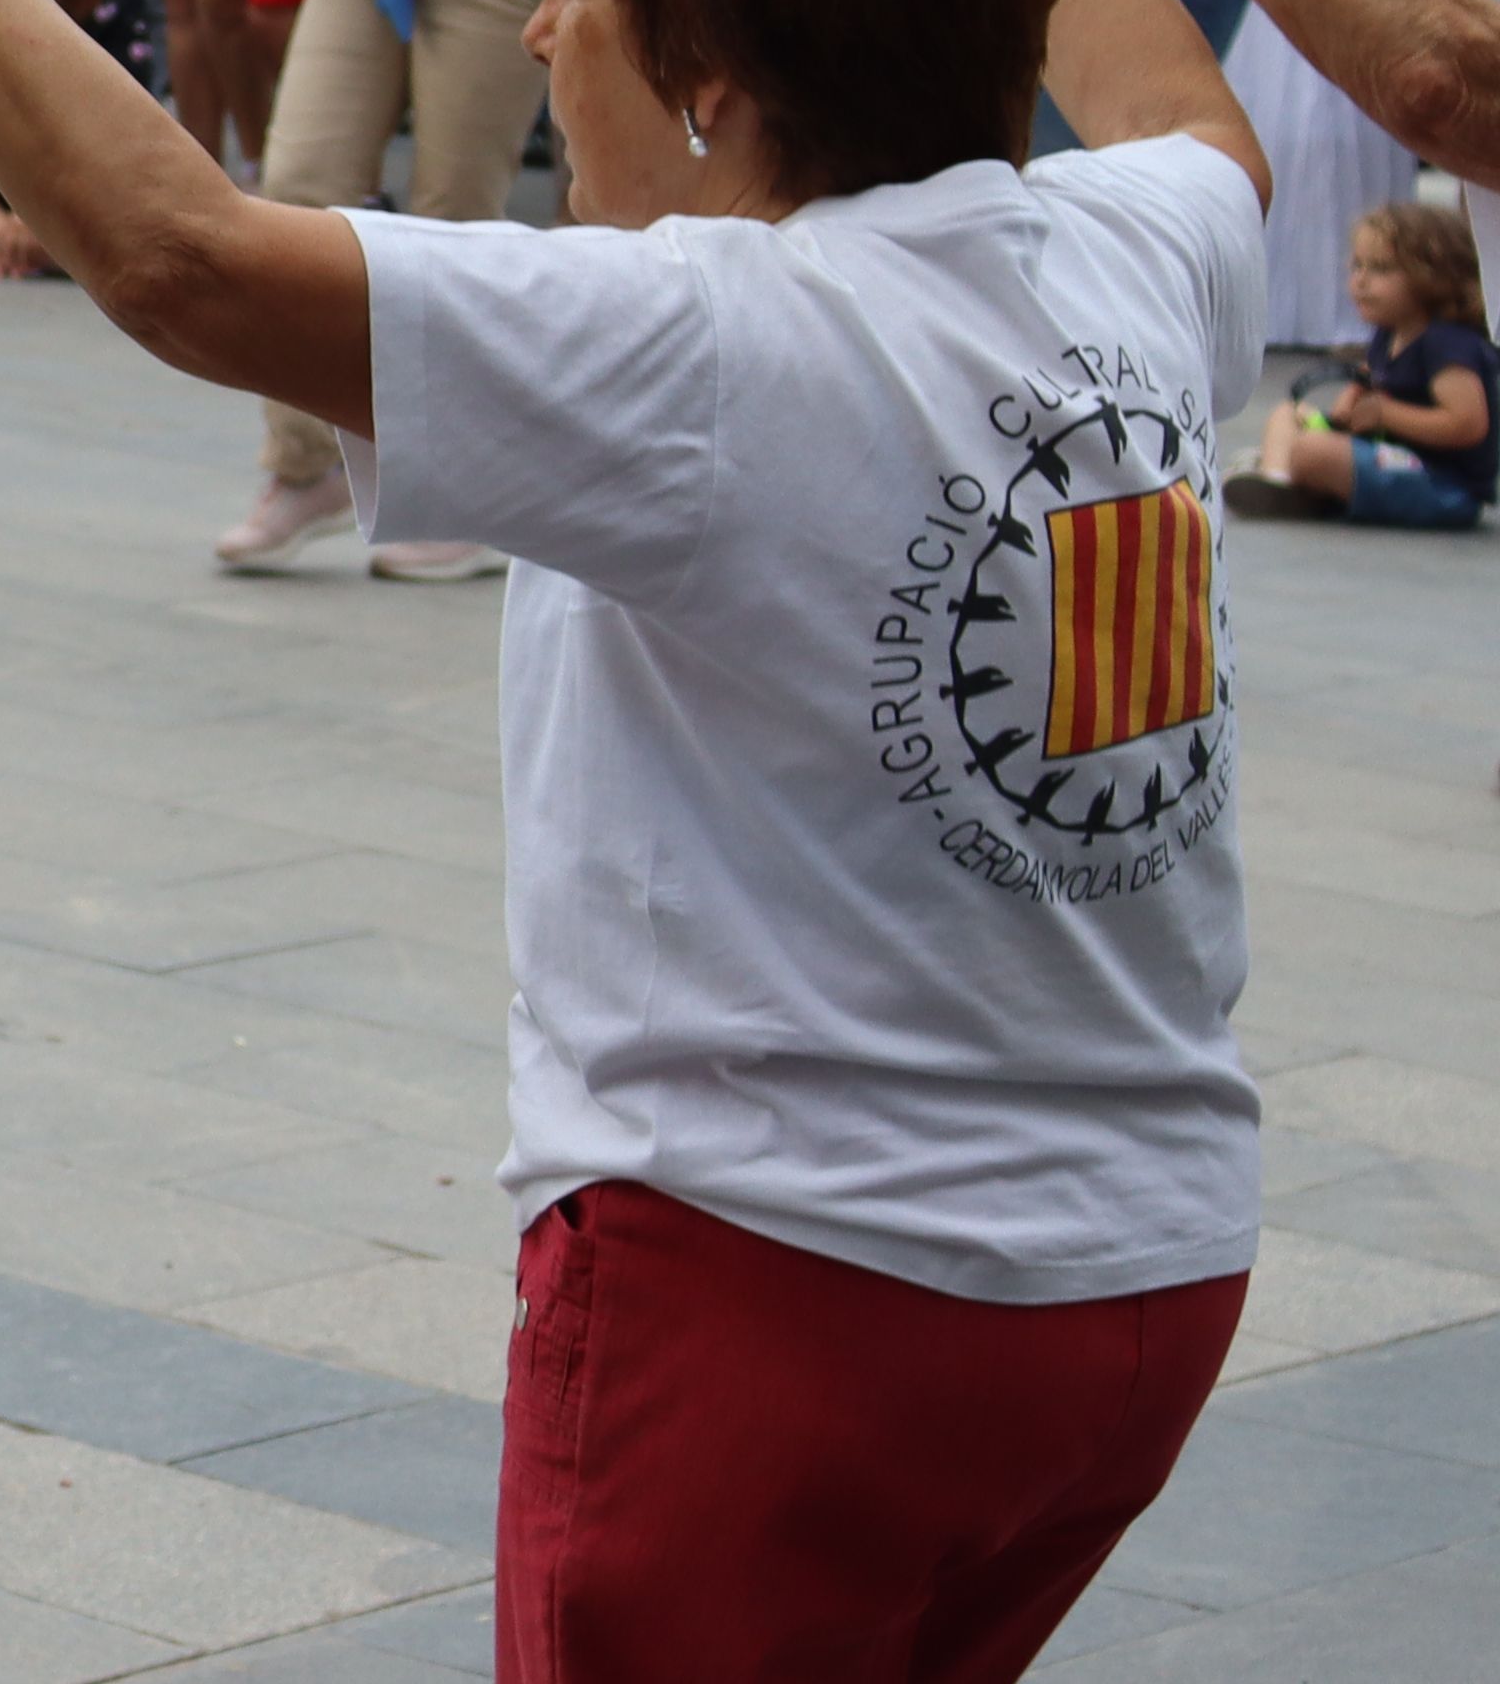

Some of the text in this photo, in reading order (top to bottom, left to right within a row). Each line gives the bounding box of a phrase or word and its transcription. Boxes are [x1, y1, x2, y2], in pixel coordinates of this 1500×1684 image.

[871, 344, 1161, 803] AGRUPACIÓ CULTRAL
[1130, 839, 1176, 893] DEL
